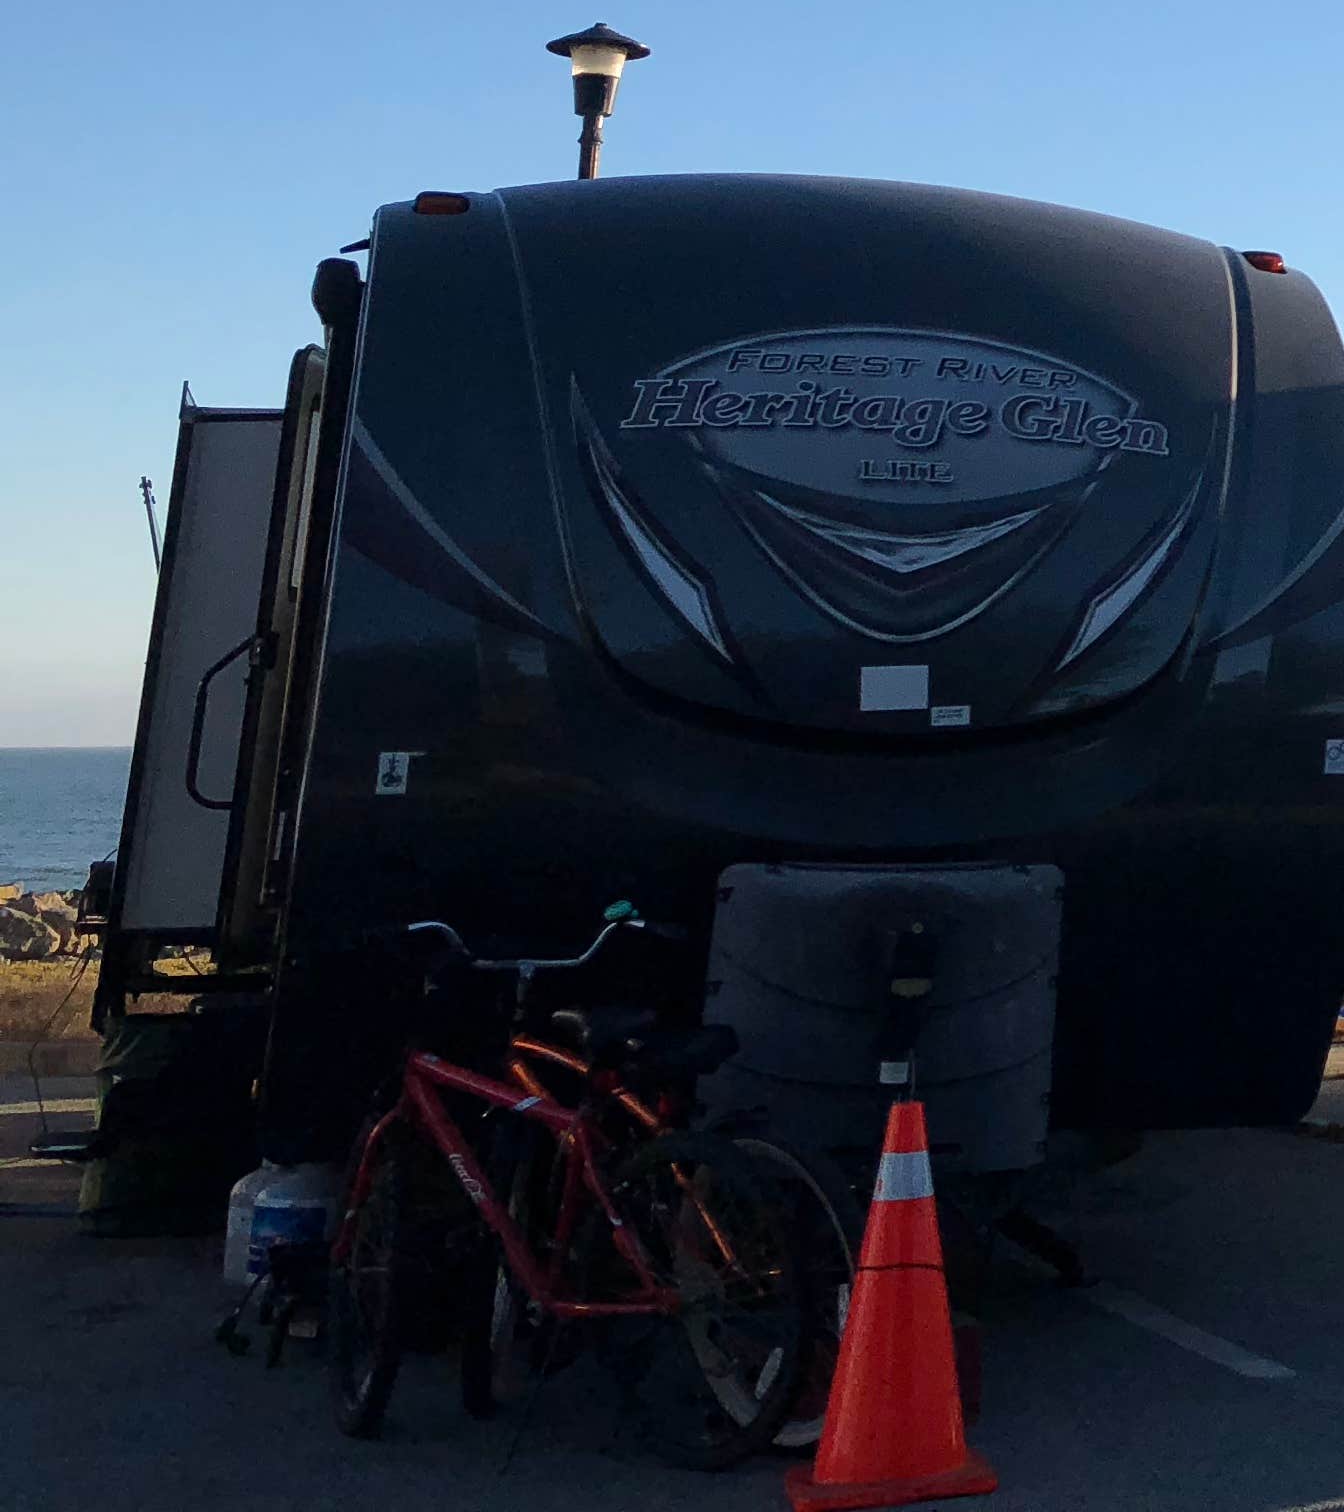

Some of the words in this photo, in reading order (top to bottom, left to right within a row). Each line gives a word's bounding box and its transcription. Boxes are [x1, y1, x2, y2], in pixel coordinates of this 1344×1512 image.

[726, 348, 921, 376] FOREST
[936, 355, 1079, 389] RIVER
[619, 377, 990, 448] Heritage
[999, 388, 1170, 456] Glen
[859, 458, 955, 483] LITE
